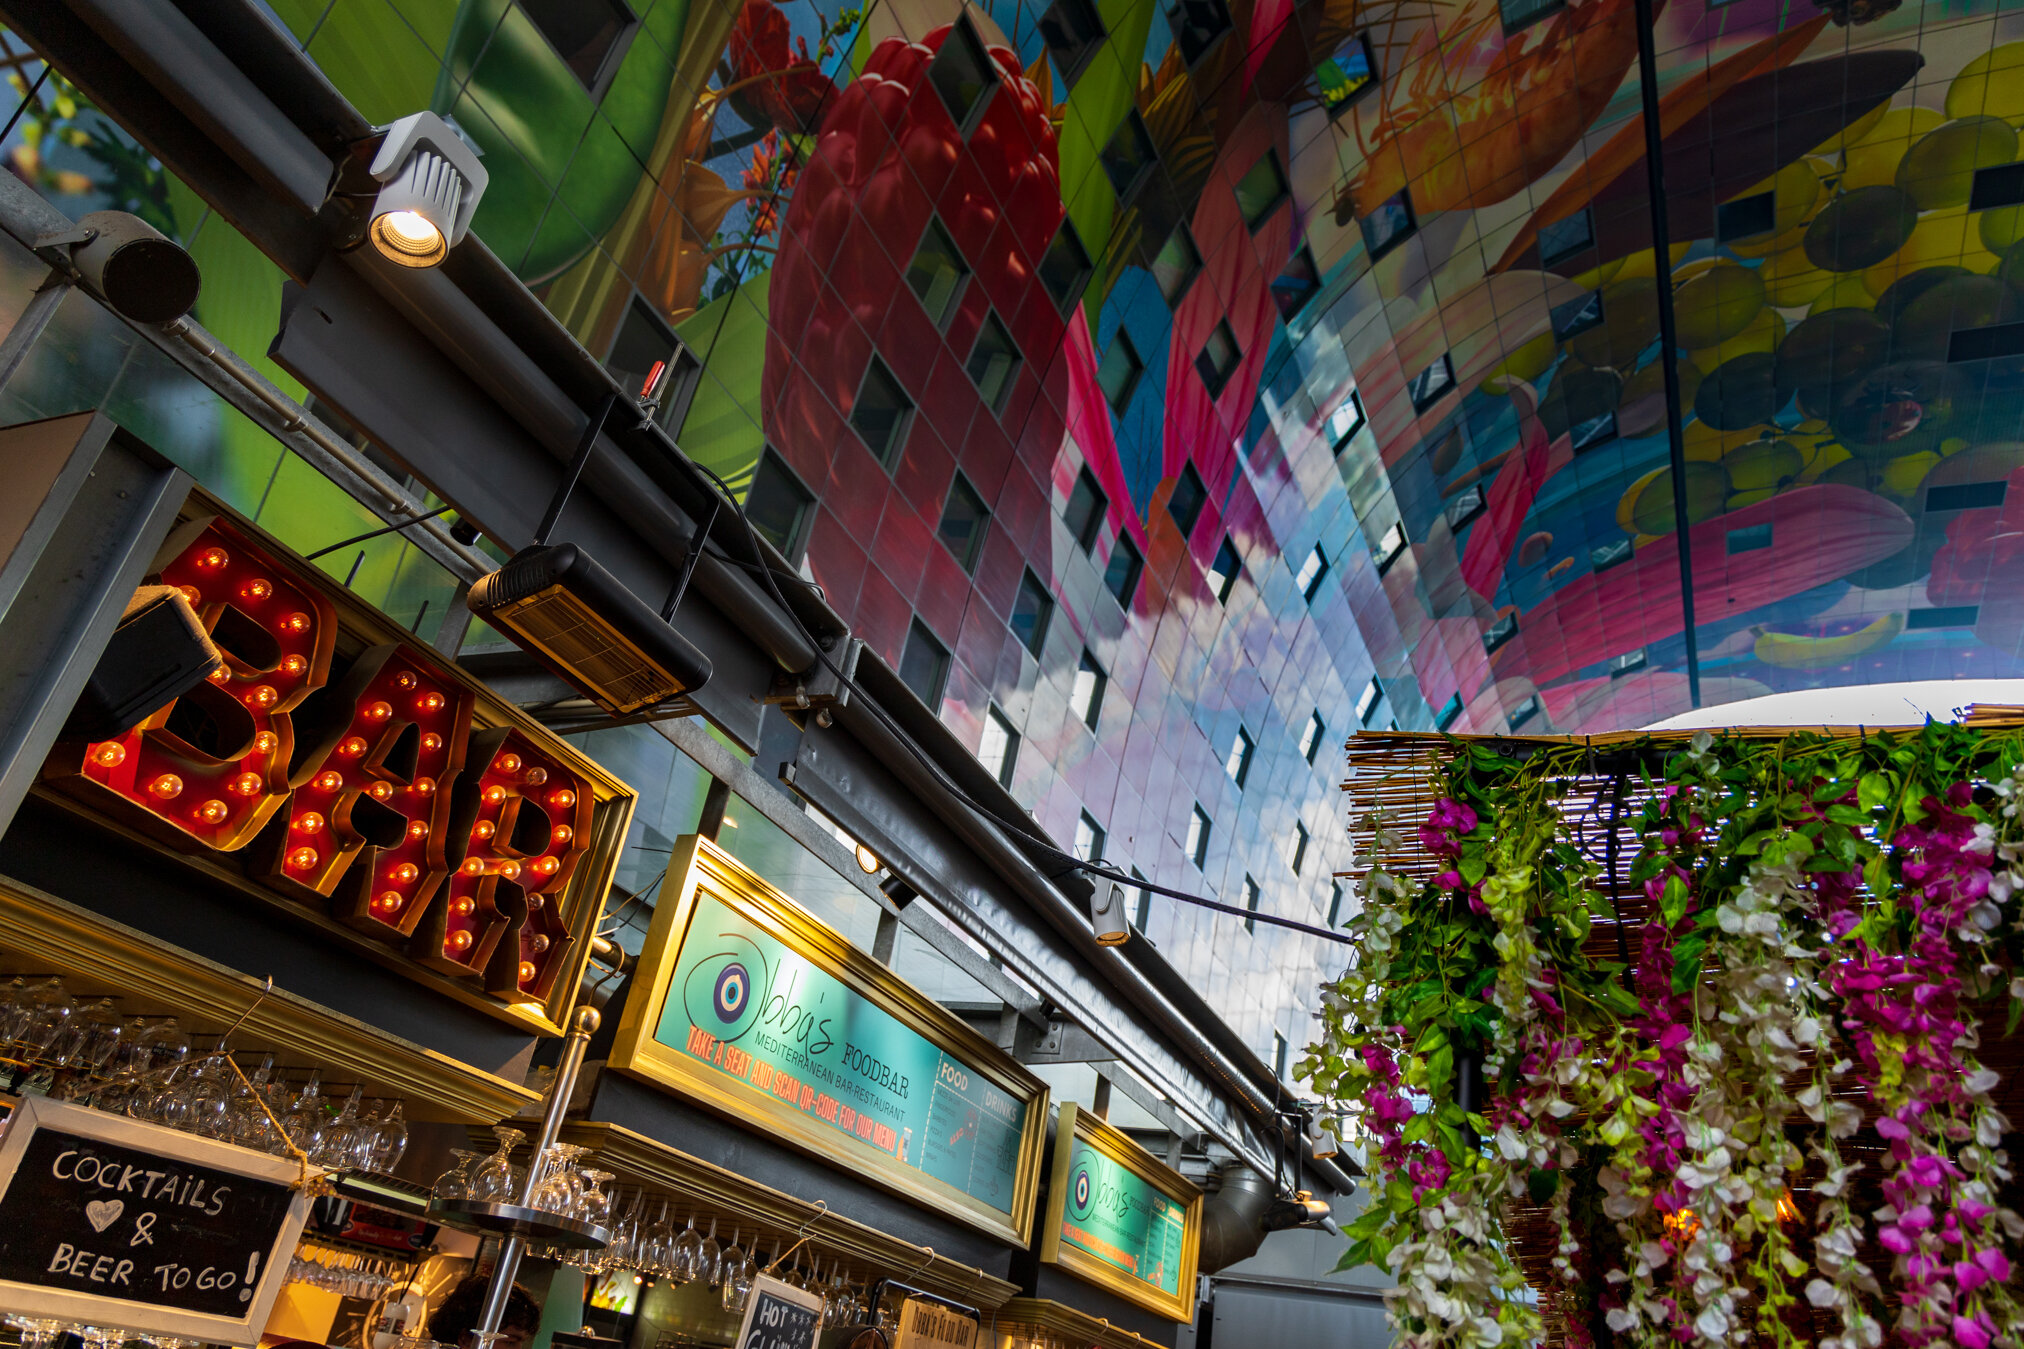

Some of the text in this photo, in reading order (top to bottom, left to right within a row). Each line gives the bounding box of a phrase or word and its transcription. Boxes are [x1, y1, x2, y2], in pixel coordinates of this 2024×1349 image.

[82, 516, 593, 1001] BAR
[686, 1025, 716, 1061] TAKE
[713, 1041, 725, 1067] A
[723, 1045, 753, 1079] SEAT
[750, 1059, 774, 1091] AND
[772, 1070, 801, 1104] SCAN
[800, 1083, 840, 1124] QR-CODE
[838, 1104, 857, 1132] FOR
[855, 1113, 873, 1141] OUR
[872, 1123, 897, 1153] MENU
[754, 1031, 906, 1122] MEDITERRANEAN BAR-RESTAURANT
[841, 1042, 910, 1099] FOODBAR
[941, 1062, 968, 1091] FOOD
[985, 1091, 1017, 1122] DRINKS
[130, 1212, 157, 1247] &
[47, 1243, 135, 1286] BEER
[759, 1298, 789, 1328] HOT
